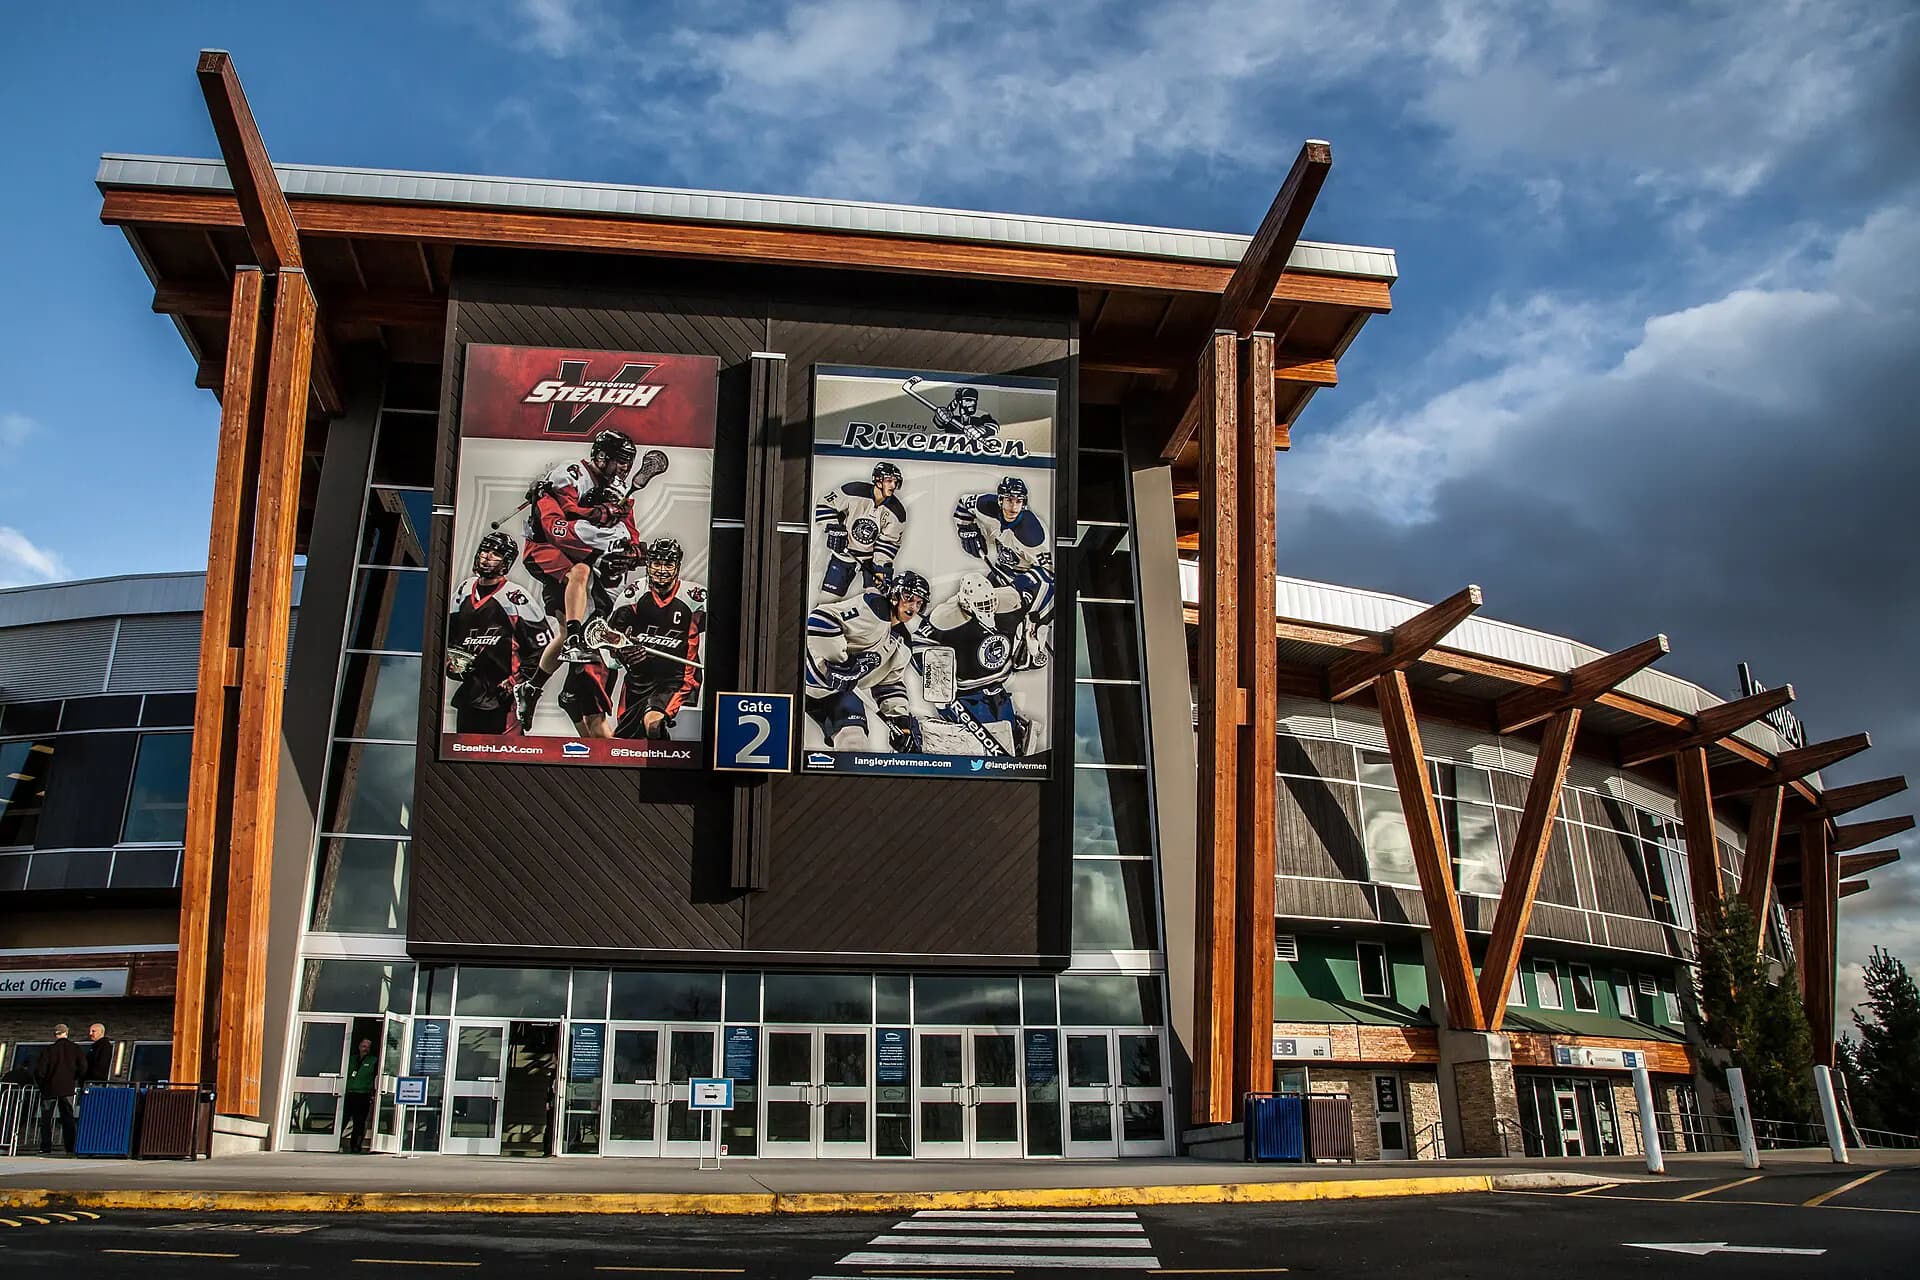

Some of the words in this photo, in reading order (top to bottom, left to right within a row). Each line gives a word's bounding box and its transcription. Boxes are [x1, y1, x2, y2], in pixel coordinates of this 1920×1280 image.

[584, 381, 637, 389] VANCOUVER
[524, 381, 664, 407] STEALTH
[890, 421, 928, 432] Langley
[842, 421, 1029, 458] Rivermen
[673, 611, 682, 624] C
[535, 629, 554, 647] 91
[737, 699, 773, 713] Gate
[950, 700, 1003, 757] Reebok
[735, 714, 771, 764] 2
[452, 743, 543, 754] StealthLAX.com
[610, 748, 691, 759] @StealthLAX
[854, 756, 952, 768] langleyrivermen.com
[984, 761, 1047, 770] @langleyrivermen
[30, 978, 67, 992] Office
[1286, 1042, 1294, 1054] 3
